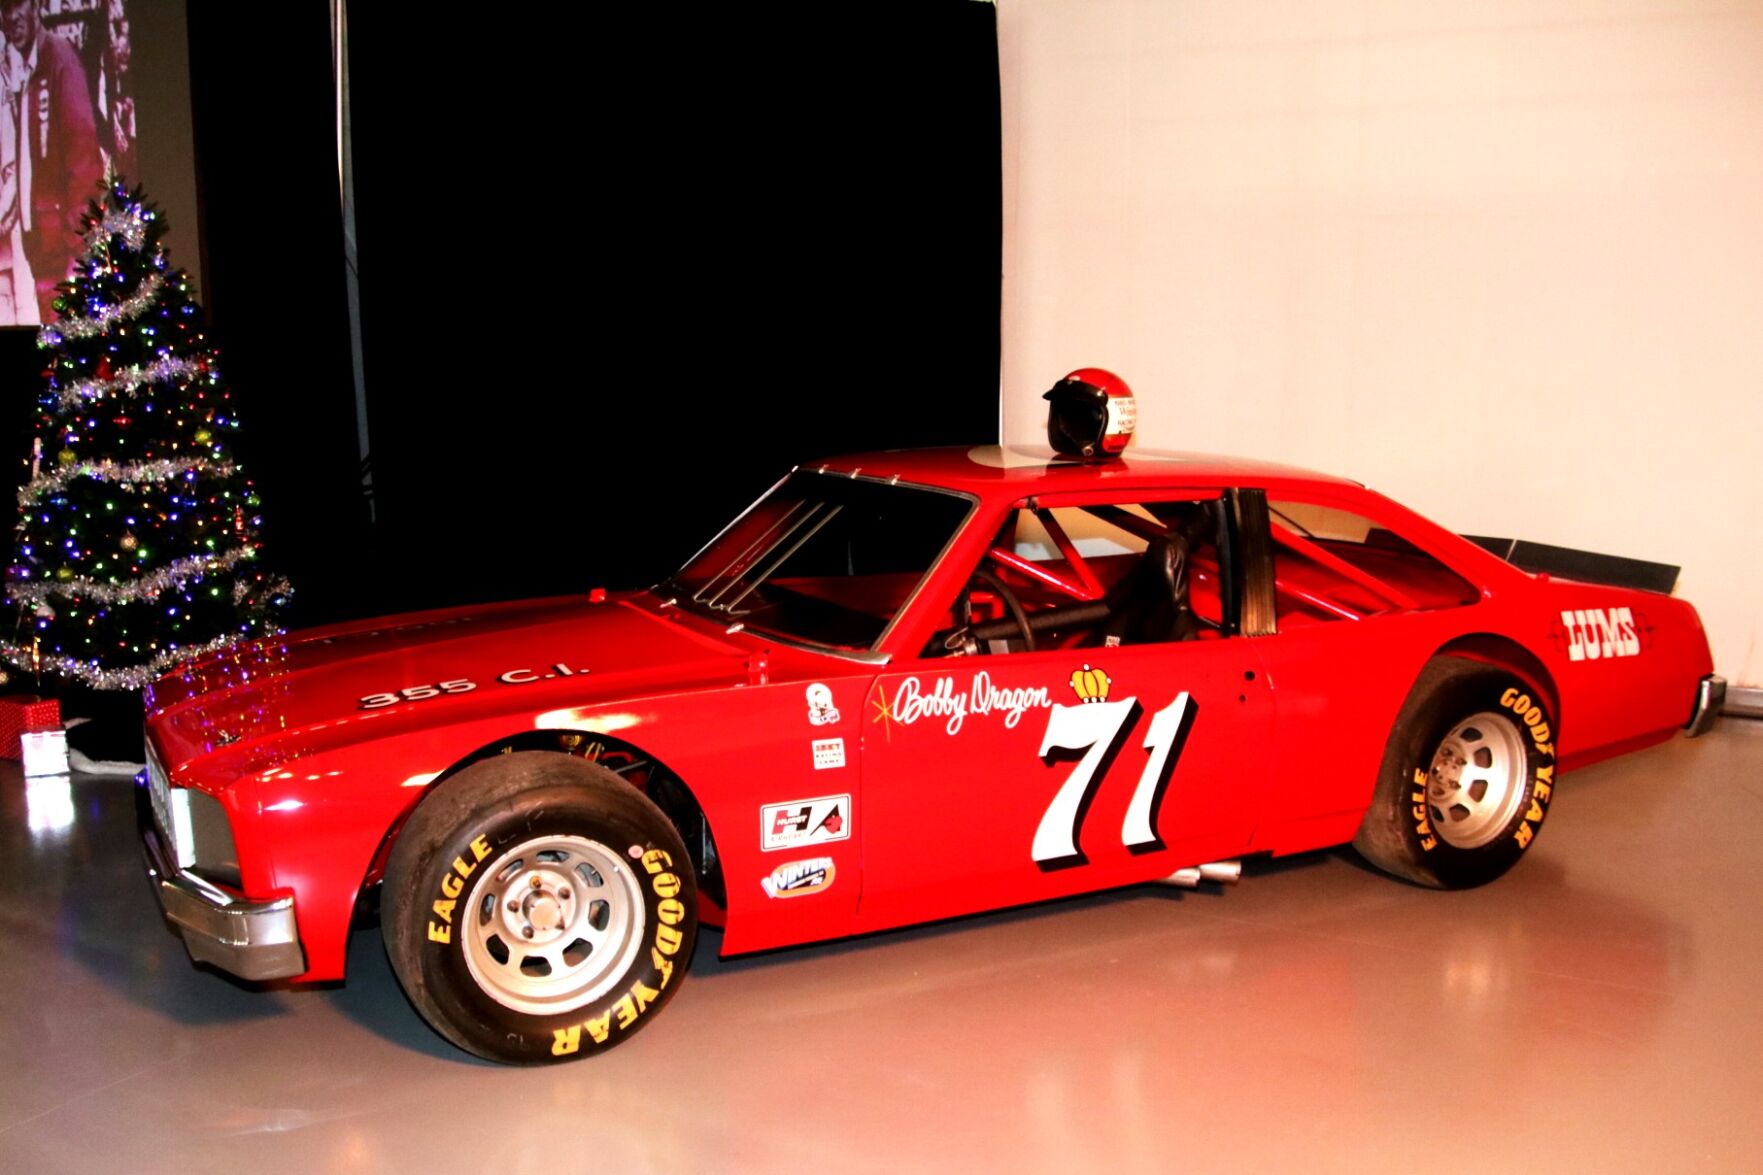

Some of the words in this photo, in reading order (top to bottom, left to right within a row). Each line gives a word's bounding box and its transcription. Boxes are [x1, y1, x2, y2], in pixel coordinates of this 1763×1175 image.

[1561, 607, 1640, 661] LUMS
[357, 678, 477, 709] 355
[893, 677, 968, 735] Bobby
[970, 671, 1051, 728] Dragon
[1032, 691, 1198, 871] 71
[1412, 768, 1437, 851] EAGLE
[1500, 688, 1554, 849] GOODYEAR
[428, 833, 492, 944] EAGLE
[551, 850, 685, 1056] GOODYEAR
